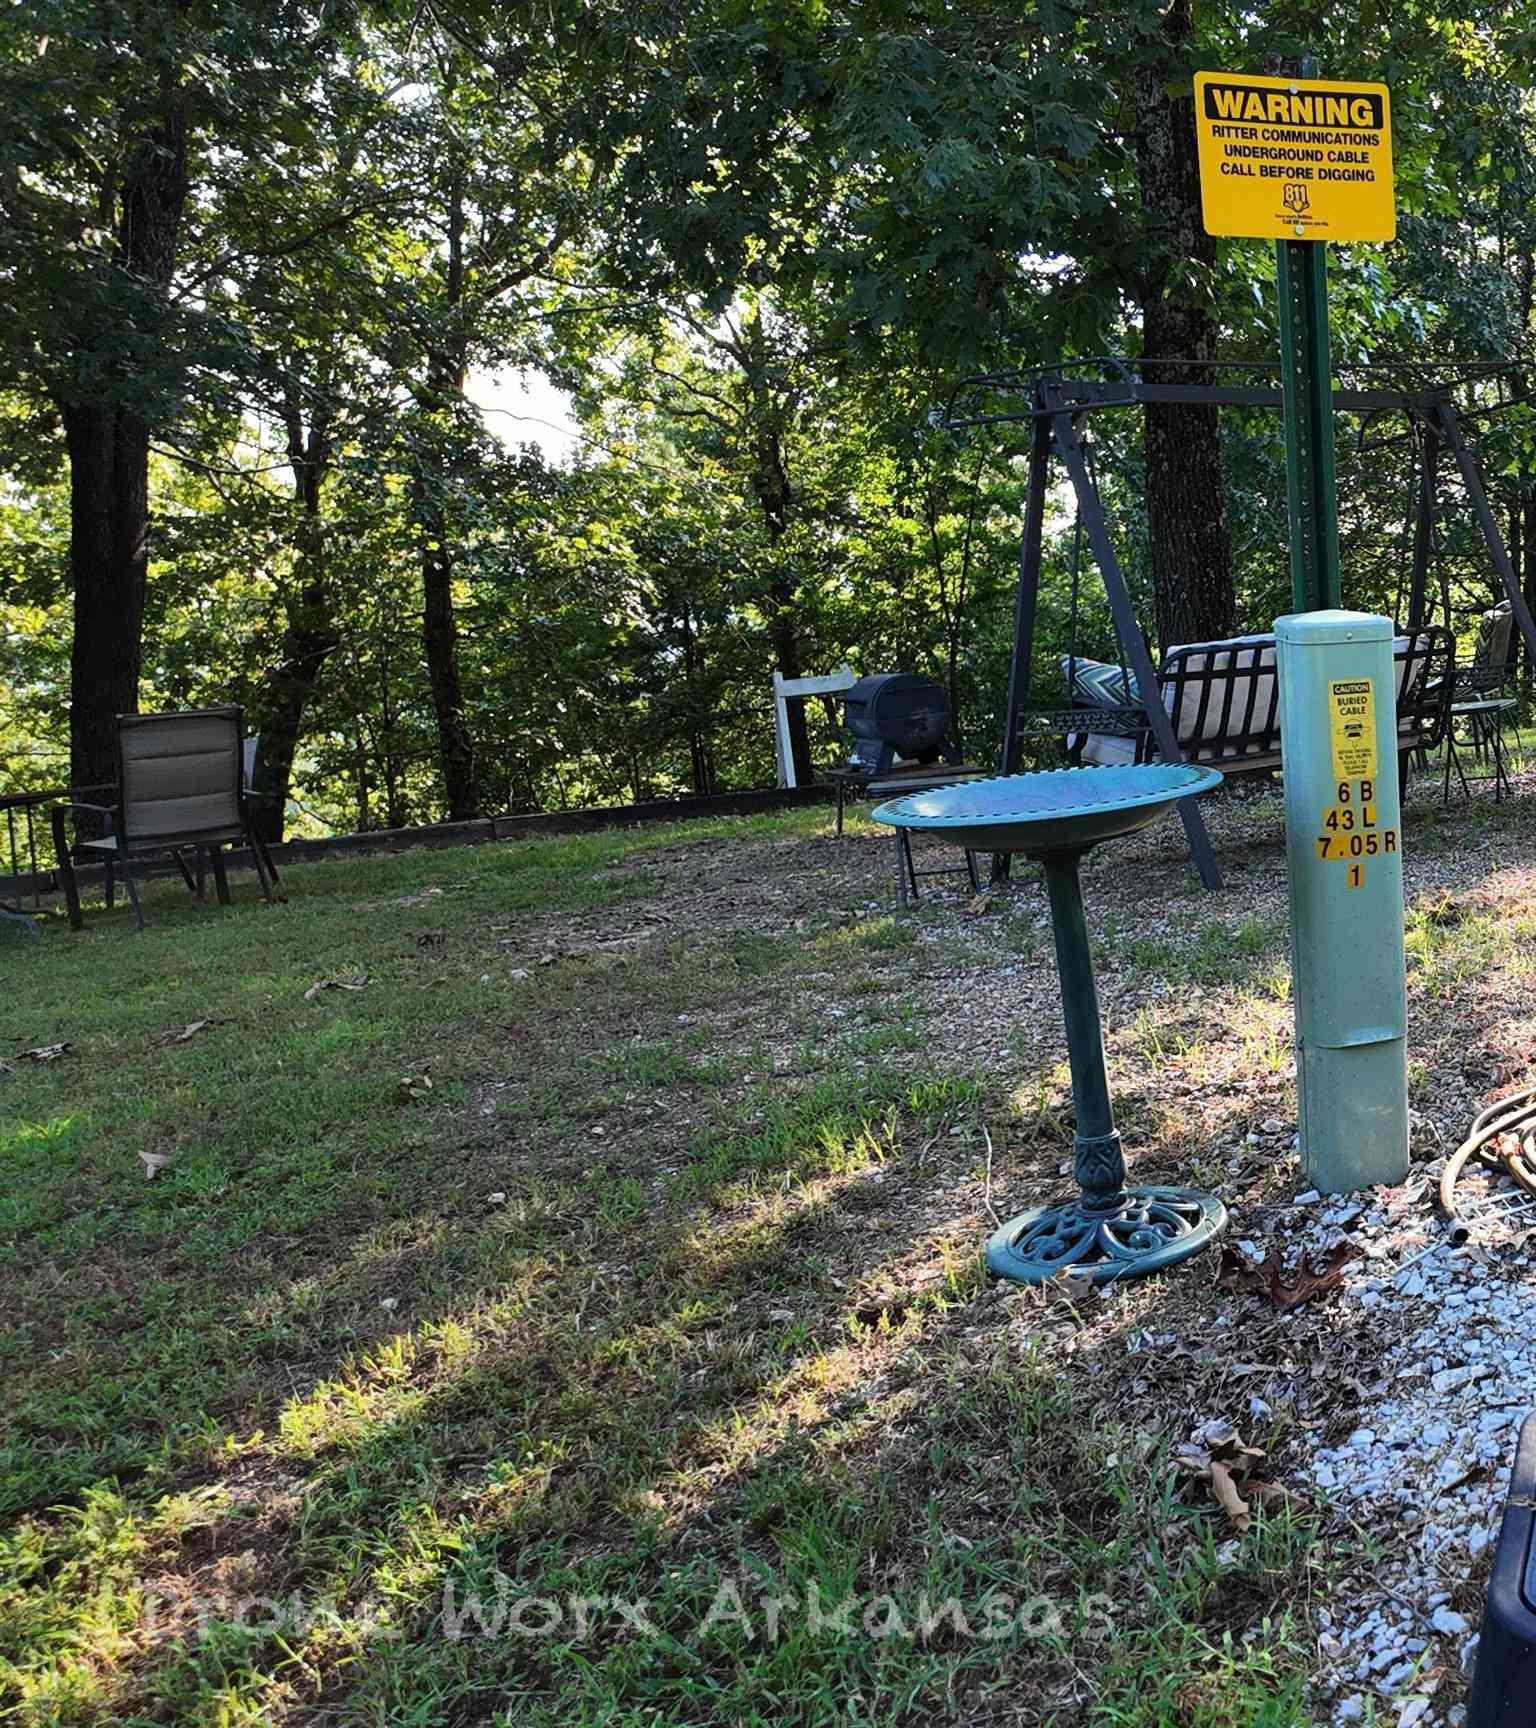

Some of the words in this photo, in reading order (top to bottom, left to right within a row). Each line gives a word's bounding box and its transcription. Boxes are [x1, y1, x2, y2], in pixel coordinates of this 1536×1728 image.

[1212, 89, 1374, 127] WARNING
[1212, 125, 1258, 140] RITTER
[1261, 129, 1380, 146] COMMUNICATIONS
[1224, 144, 1323, 162] UNDERGROUND
[1327, 151, 1370, 163] CABLE
[1221, 162, 1255, 176] CALL
[1259, 165, 1314, 180] BEFORE
[1318, 168, 1375, 182] DIGGING
[1283, 183, 1307, 202] 811
[1334, 683, 1369, 694] CAUTION
[1337, 696, 1368, 706] BURIED
[1340, 706, 1366, 716] CABLE
[1338, 782, 1350, 804] 6
[1361, 780, 1373, 802] B
[1325, 810, 1354, 831] 43
[1362, 807, 1376, 828] L
[1318, 834, 1378, 858] 7.05
[1384, 830, 1396, 852] R
[1350, 865, 1360, 887] 1
